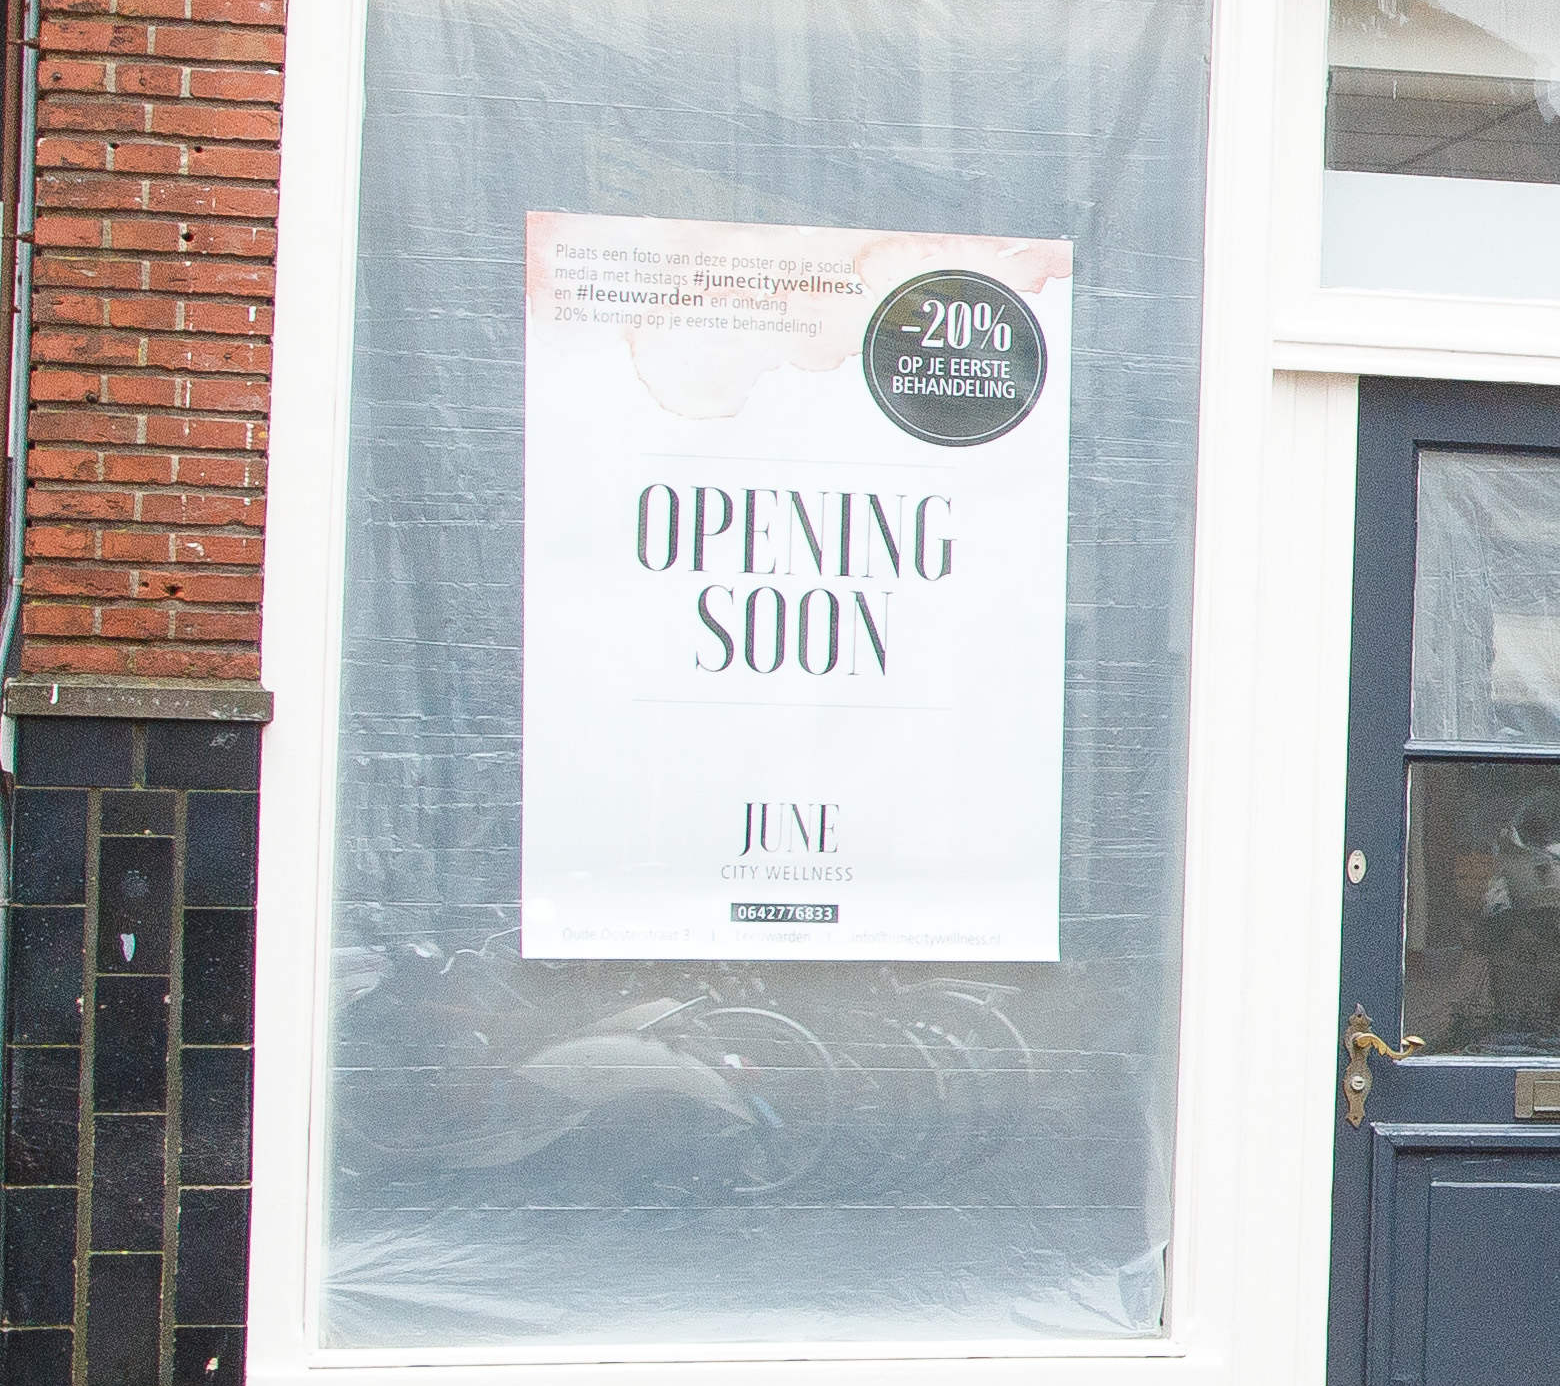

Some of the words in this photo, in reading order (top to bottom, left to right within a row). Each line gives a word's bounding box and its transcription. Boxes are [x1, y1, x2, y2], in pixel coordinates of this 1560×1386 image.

[555, 244, 598, 260] Plaats
[602, 250, 628, 262] een
[633, 248, 661, 263] foto
[665, 253, 690, 265] van
[695, 252, 727, 267] deze
[732, 255, 774, 271] poster
[778, 258, 796, 272] op
[800, 258, 814, 275] je
[817, 259, 856, 274] social
[555, 266, 598, 282] media
[603, 270, 630, 283] met
[634, 270, 688, 287] hastags
[693, 270, 863, 295] #junecitywellness
[554, 288, 571, 300] en
[576, 284, 703, 307] #leeuwarden
[710, 297, 727, 308] en
[732, 297, 787, 313] ontvang
[554, 306, 587, 322] 20%
[593, 308, 642, 328] korting
[647, 314, 665, 328] op
[668, 313, 681, 330] je
[686, 316, 728, 329] eerste
[733, 317, 823, 337] behandeling!
[901, 299, 1012, 352] -20%
[898, 356, 923, 373] OP
[927, 357, 945, 375] JE
[950, 358, 1011, 379] EERSTE
[892, 375, 1016, 399] BEHANDELING
[637, 483, 957, 581] OPENING
[695, 585, 893, 677] SOON
[738, 802, 839, 857] JUNE
[721, 865, 759, 880] CITY
[766, 865, 853, 882] WELLNESS
[737, 906, 833, 921] 0642776833
[736, 930, 811, 943] Leeuwarden
